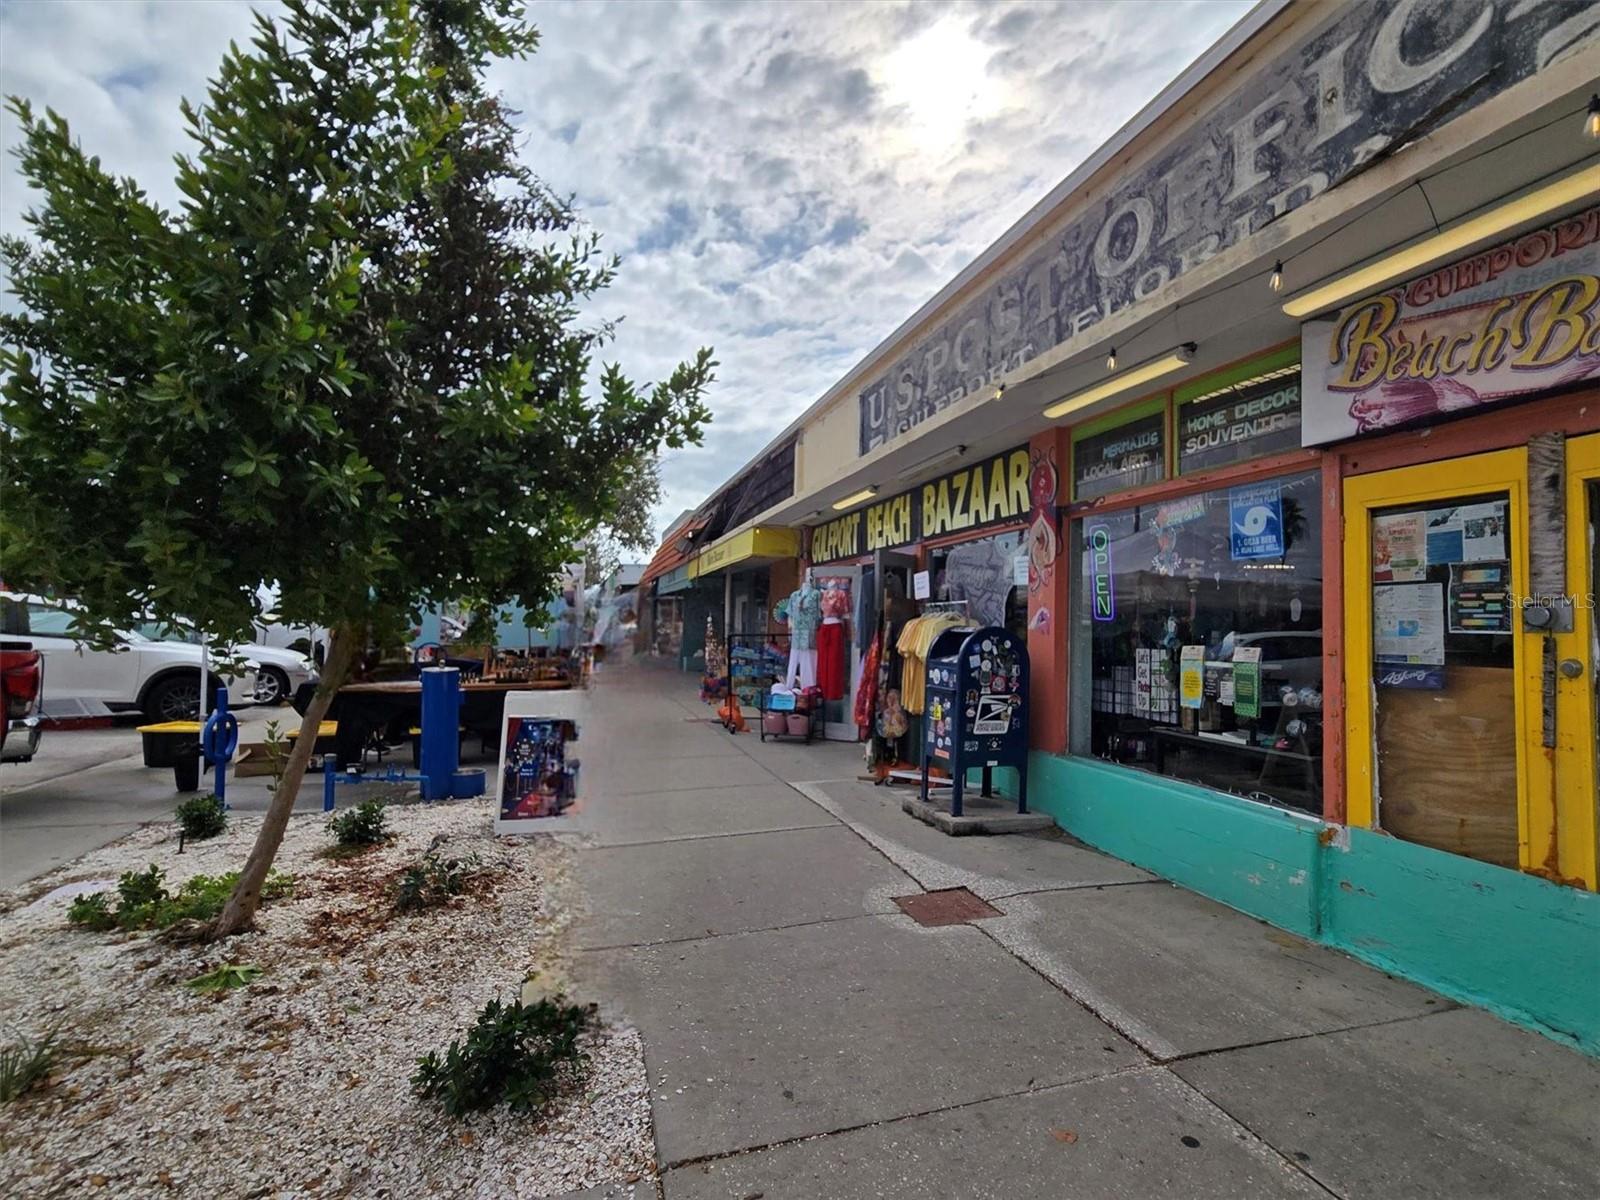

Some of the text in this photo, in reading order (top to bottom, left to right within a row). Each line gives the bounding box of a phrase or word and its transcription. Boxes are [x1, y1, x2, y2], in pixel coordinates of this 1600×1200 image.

[1094, 0, 1600, 277] OFFIC
[1327, 294, 1511, 392] Beach
[1103, 432, 1159, 460] MERMAIDS
[1187, 386, 1299, 433] HOME DECOR
[811, 450, 1030, 564] GULFPORT BEACH BAZAAR
[1083, 460, 1117, 480] LOCAL
[1093, 530, 1111, 615] OPEN
